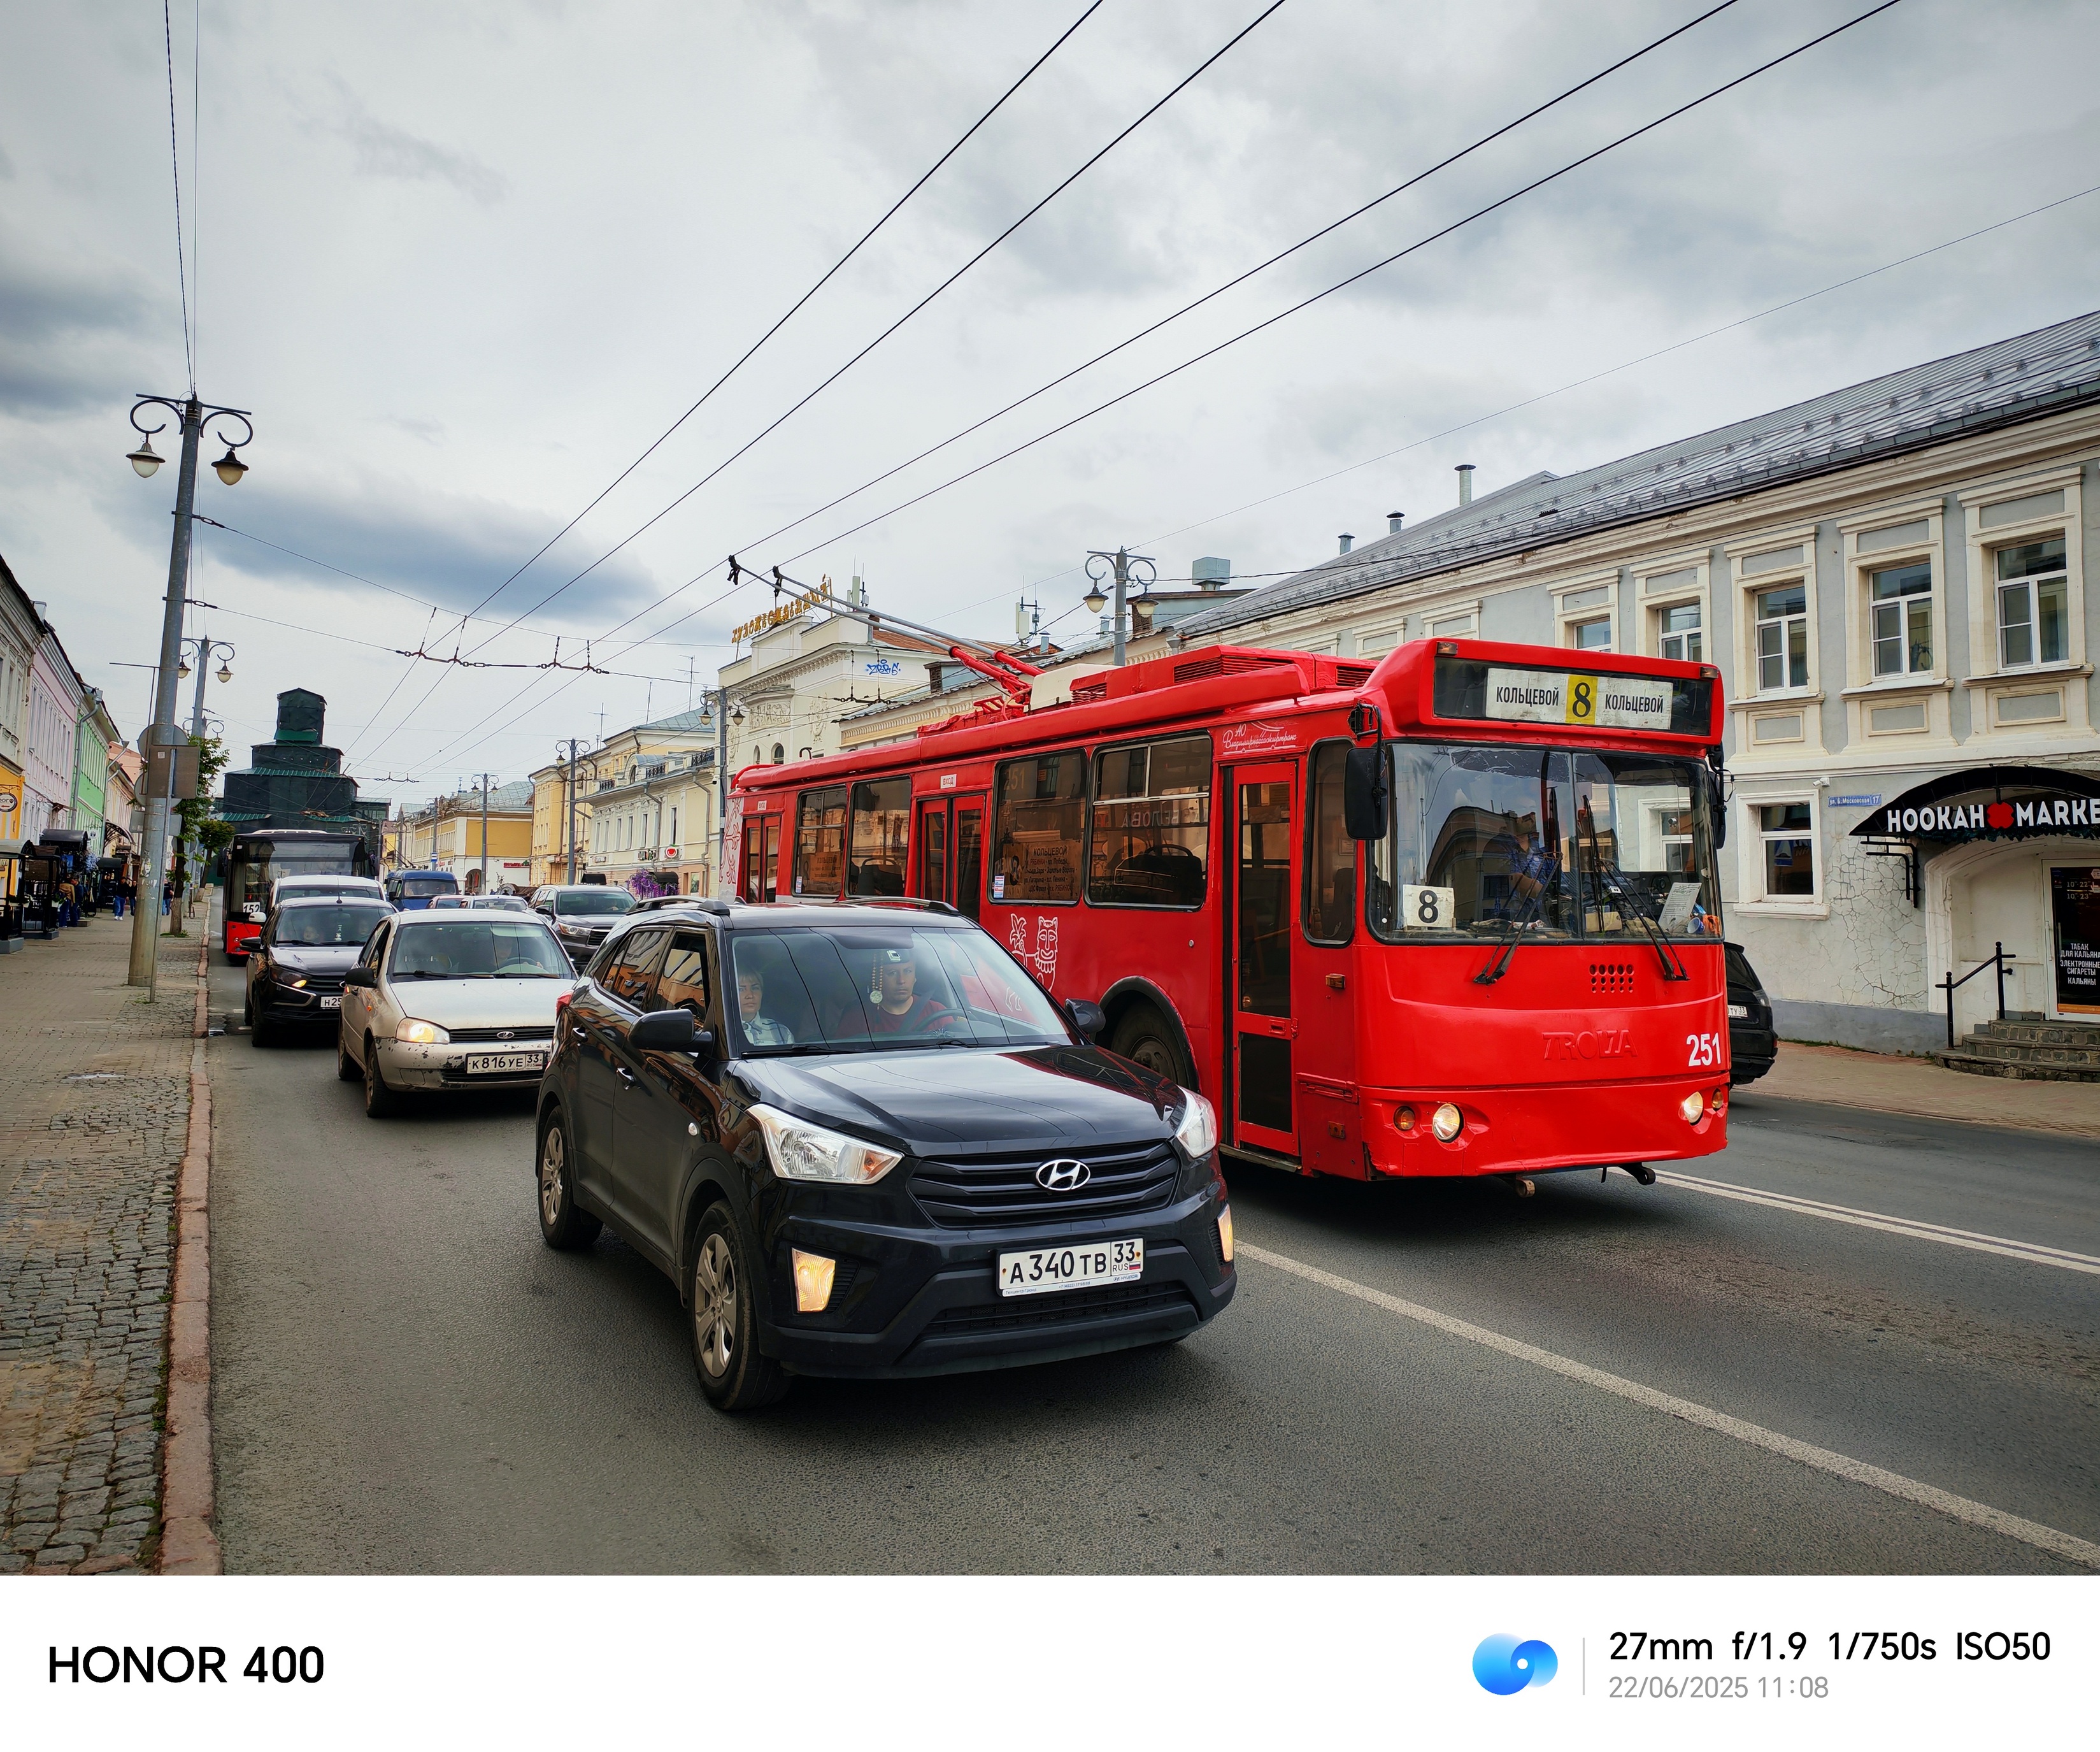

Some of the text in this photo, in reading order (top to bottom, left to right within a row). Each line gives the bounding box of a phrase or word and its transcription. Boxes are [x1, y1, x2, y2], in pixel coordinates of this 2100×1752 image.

[1497, 682, 1664, 717] КОЛЬЦЕВОЙ 8 КОЛЬЦЕВОЙ
[1234, 723, 1246, 736] АО
[1873, 796, 1879, 804] 17
[1887, 799, 2100, 832] HOOKAH MARKE
[1034, 845, 1068, 858] КОЛЬЦЕВОЙ
[1010, 856, 1019, 886] 8
[244, 905, 259, 913] 152
[1418, 890, 1438, 923] 8
[2060, 960, 2100, 968] ЭЛЕКТРОННЫЕ
[2068, 977, 2096, 986] КАЛЬЯНЫ
[1686, 1032, 1721, 1066] 251
[527, 1054, 539, 1063] 33
[1114, 1242, 1135, 1263] 33
[1113, 1263, 1128, 1272] RUS
